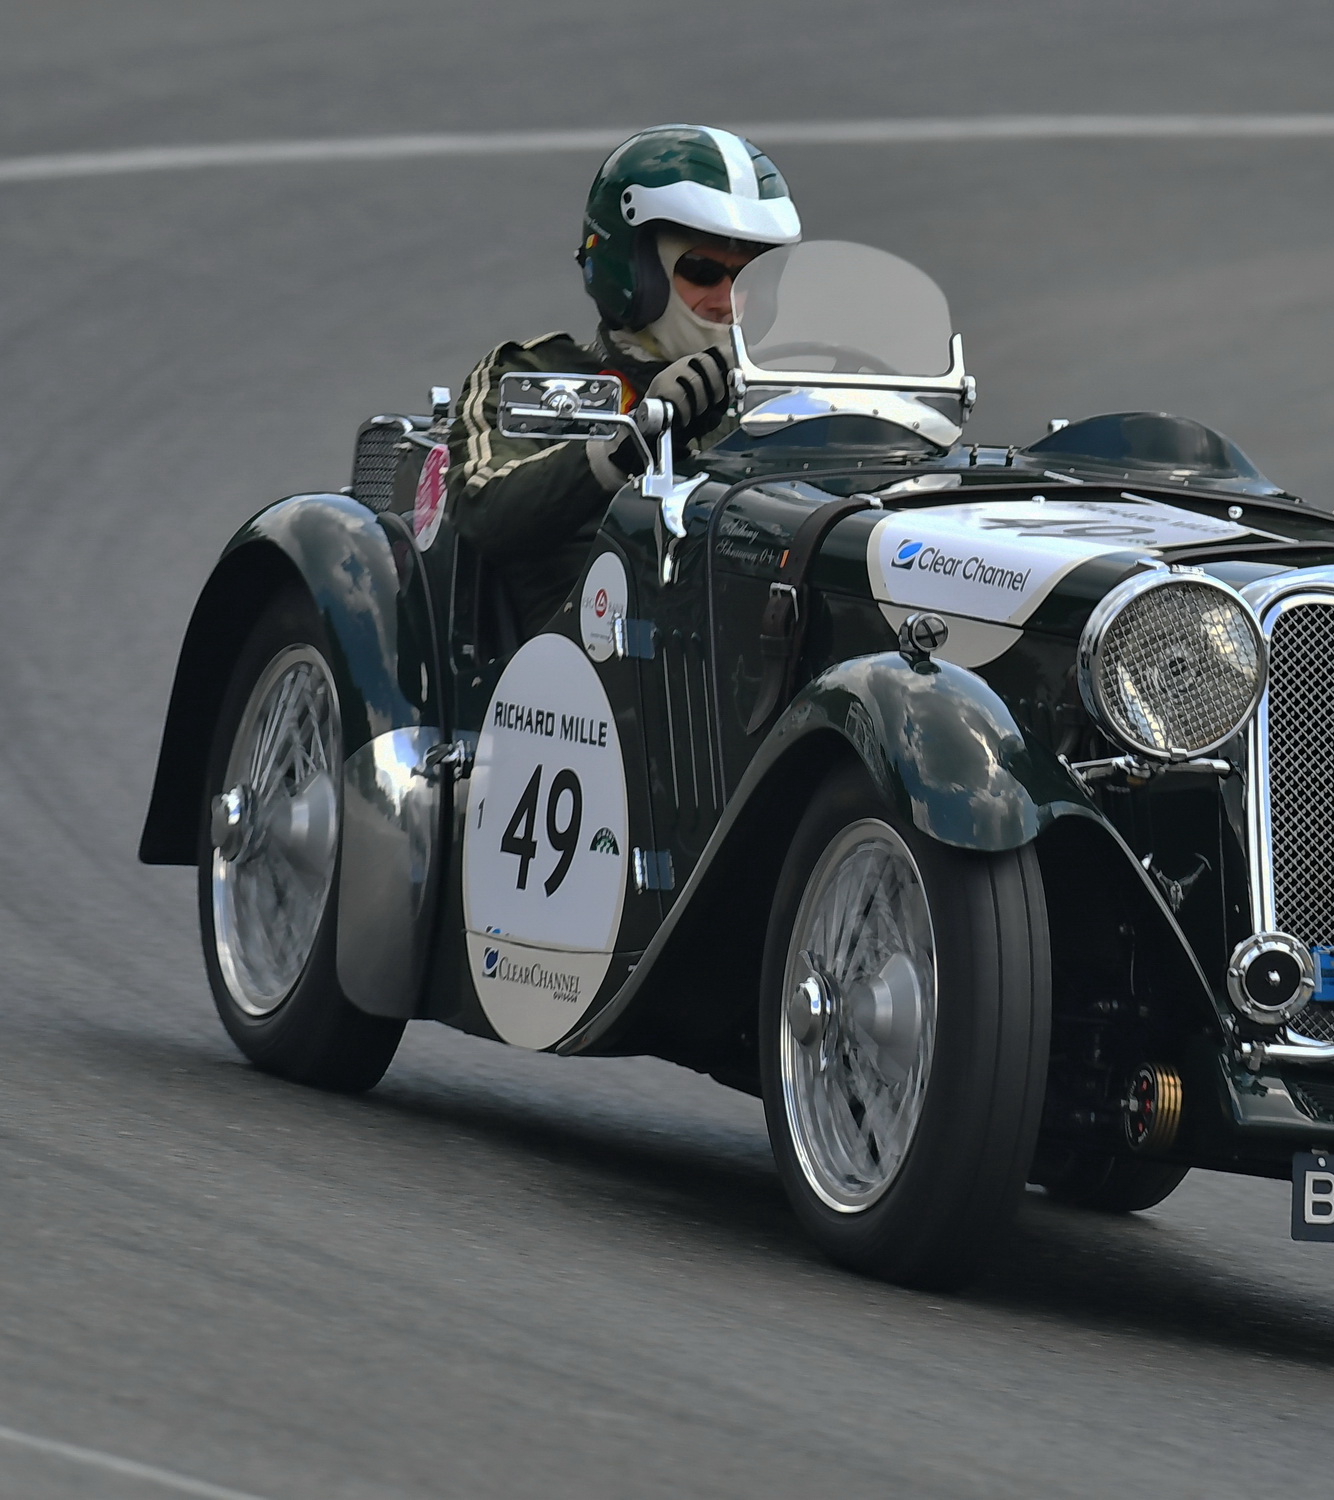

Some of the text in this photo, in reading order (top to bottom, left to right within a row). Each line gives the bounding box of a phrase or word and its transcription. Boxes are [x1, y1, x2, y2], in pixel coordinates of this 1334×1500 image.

[918, 547, 1032, 592] Clear Channel
[494, 700, 608, 748] RICHARD MILLE
[477, 797, 486, 830] 1
[500, 763, 583, 898] 49
